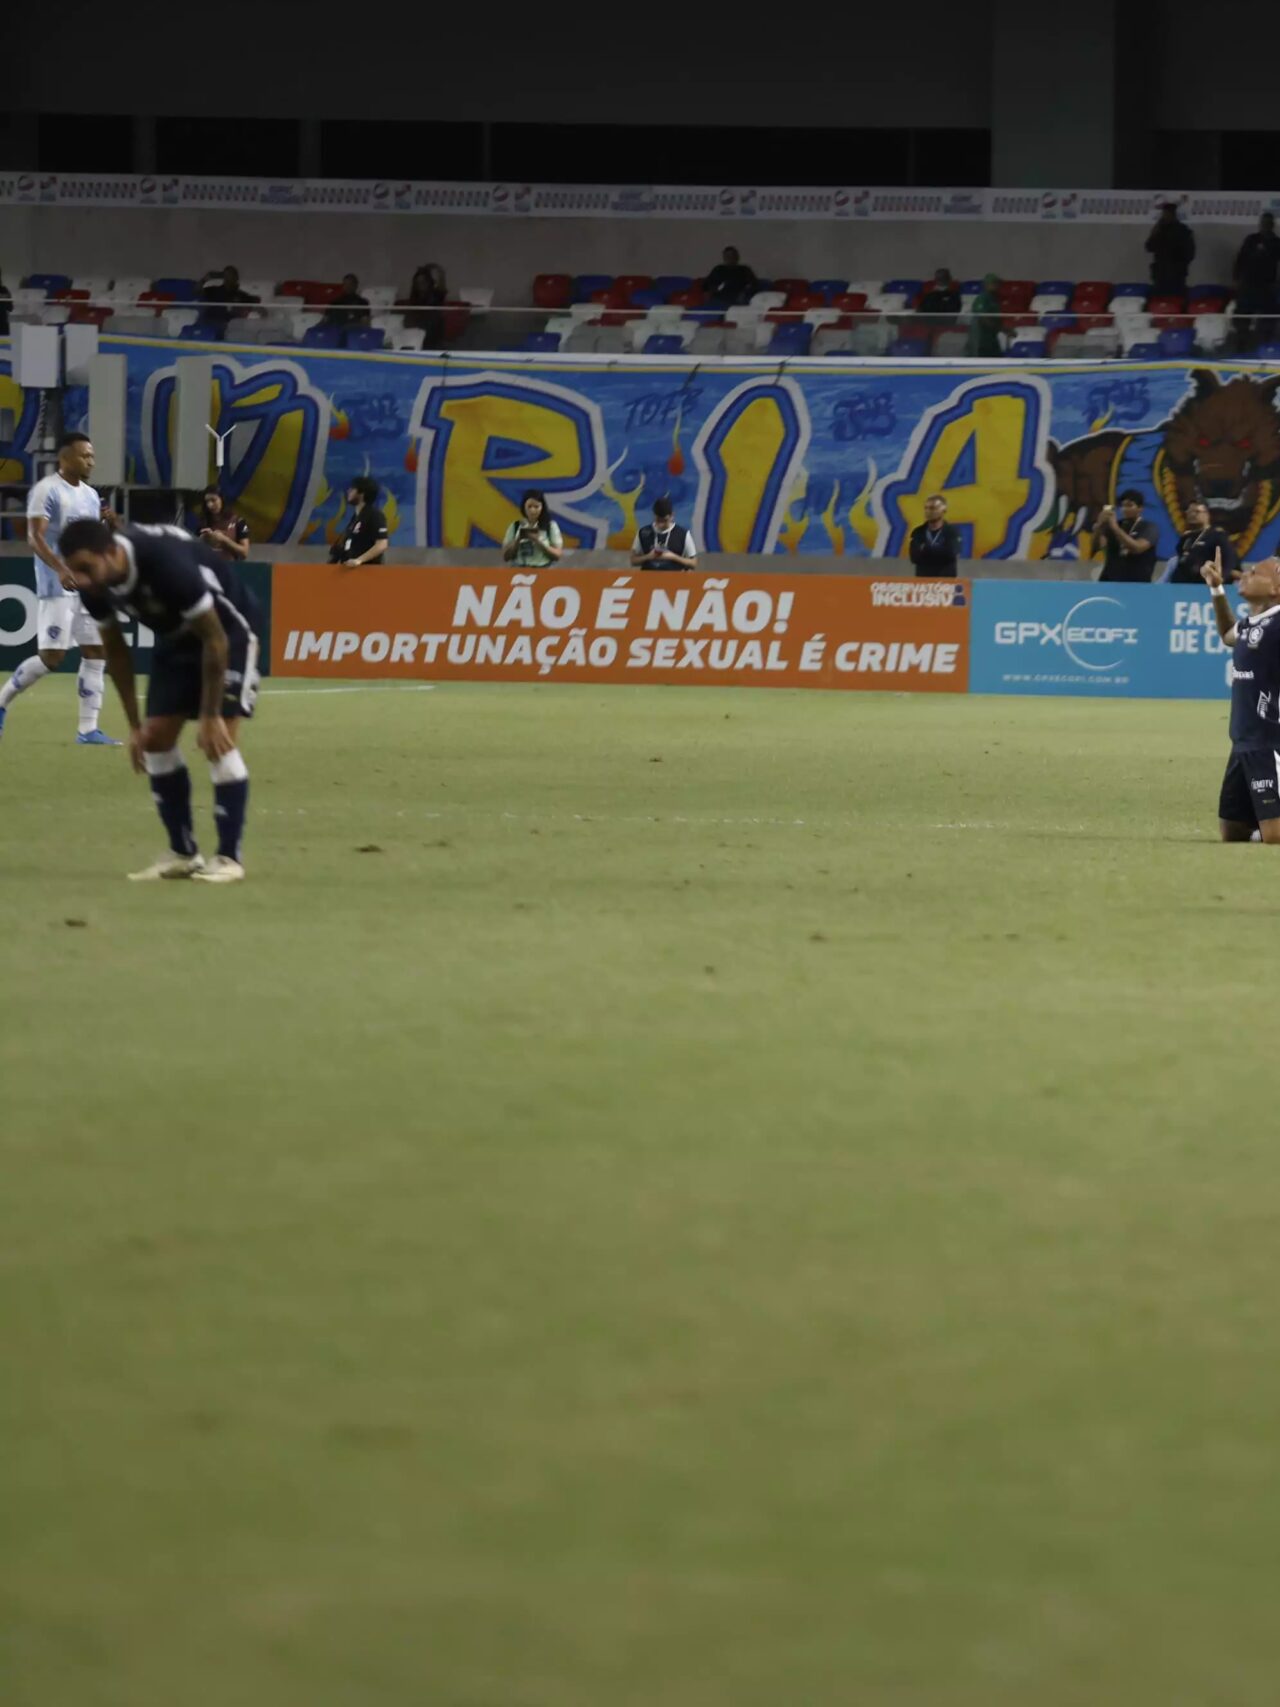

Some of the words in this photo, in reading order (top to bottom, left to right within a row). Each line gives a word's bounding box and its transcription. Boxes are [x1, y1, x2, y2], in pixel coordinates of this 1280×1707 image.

[452, 573, 581, 629] NÃO
[595, 576, 635, 630] É
[645, 578, 795, 635] NÃO!
[1174, 601, 1217, 629] FAÇ
[283, 628, 618, 675] IMPORTUNAÇÃO
[626, 638, 788, 671] SEXUAL
[799, 633, 827, 671] É
[835, 642, 960, 673] CRIME
[1170, 629, 1199, 653] DE
